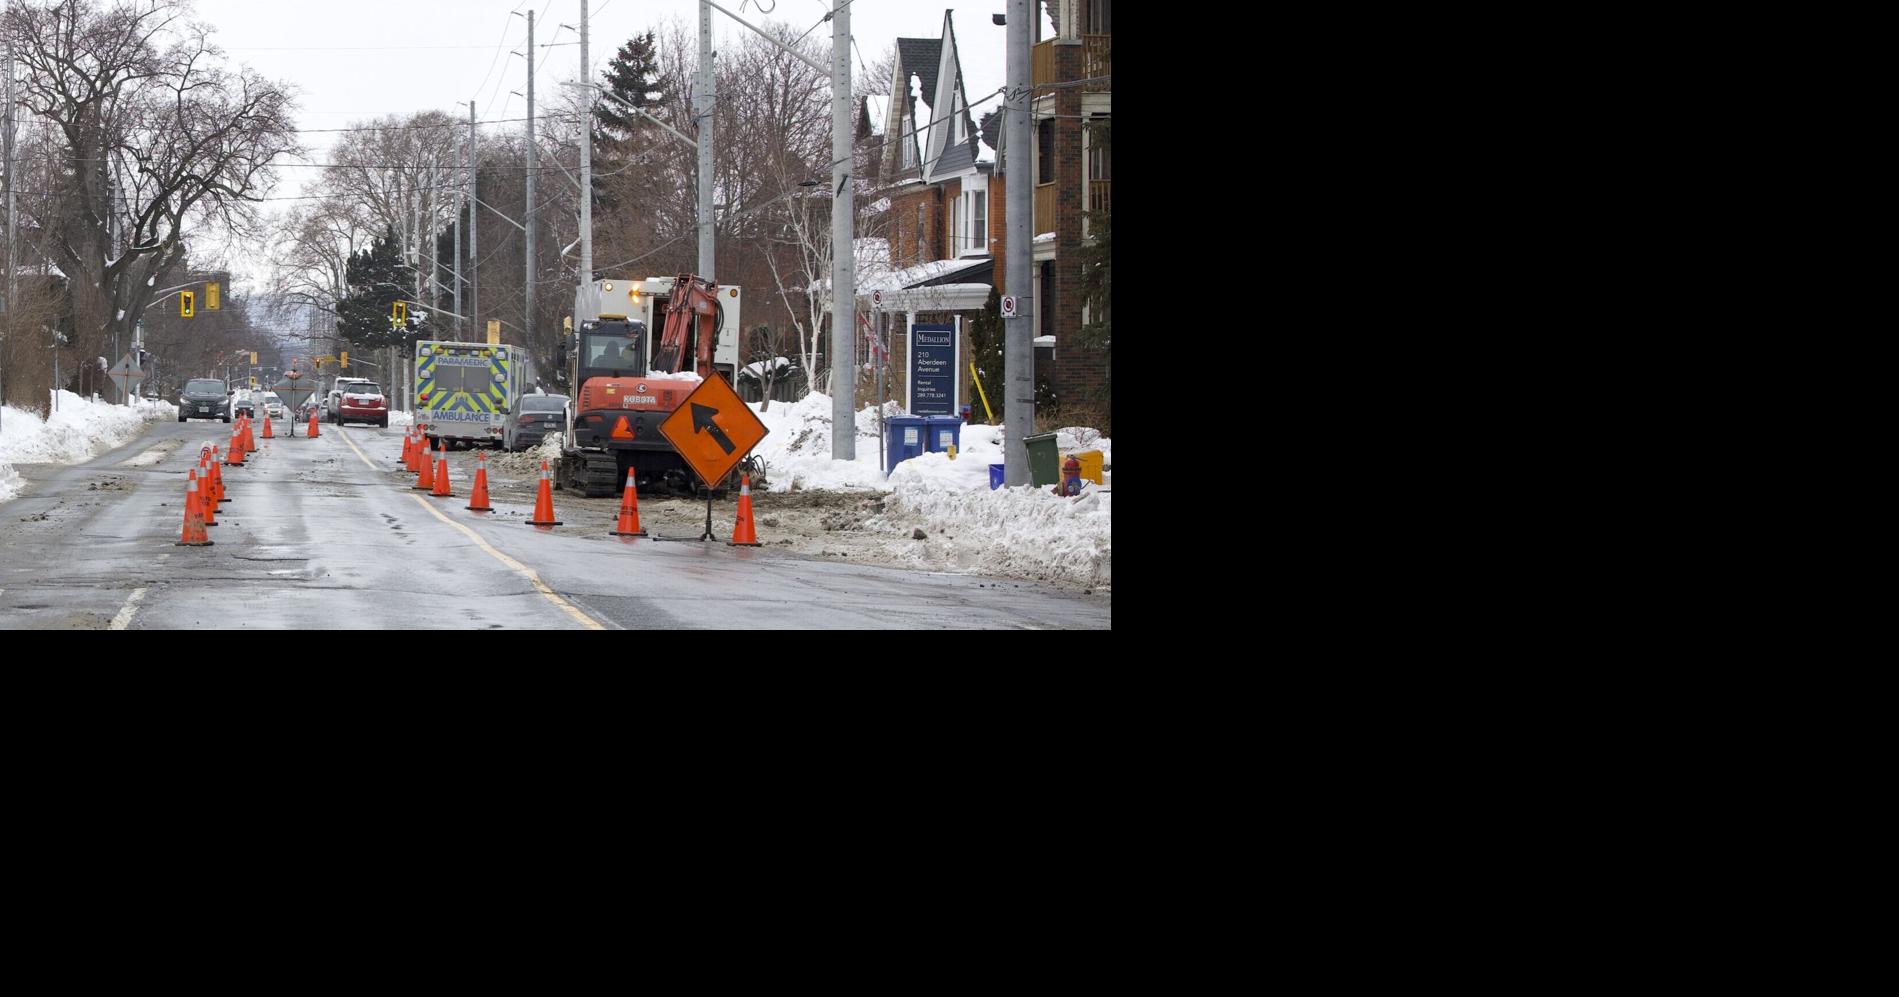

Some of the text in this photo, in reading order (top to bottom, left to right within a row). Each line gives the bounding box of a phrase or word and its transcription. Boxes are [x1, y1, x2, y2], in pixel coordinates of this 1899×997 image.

[438, 357, 489, 367] PARAMEDIC
[623, 395, 656, 404] KUBOTA
[433, 411, 489, 422] AMBULANCE
